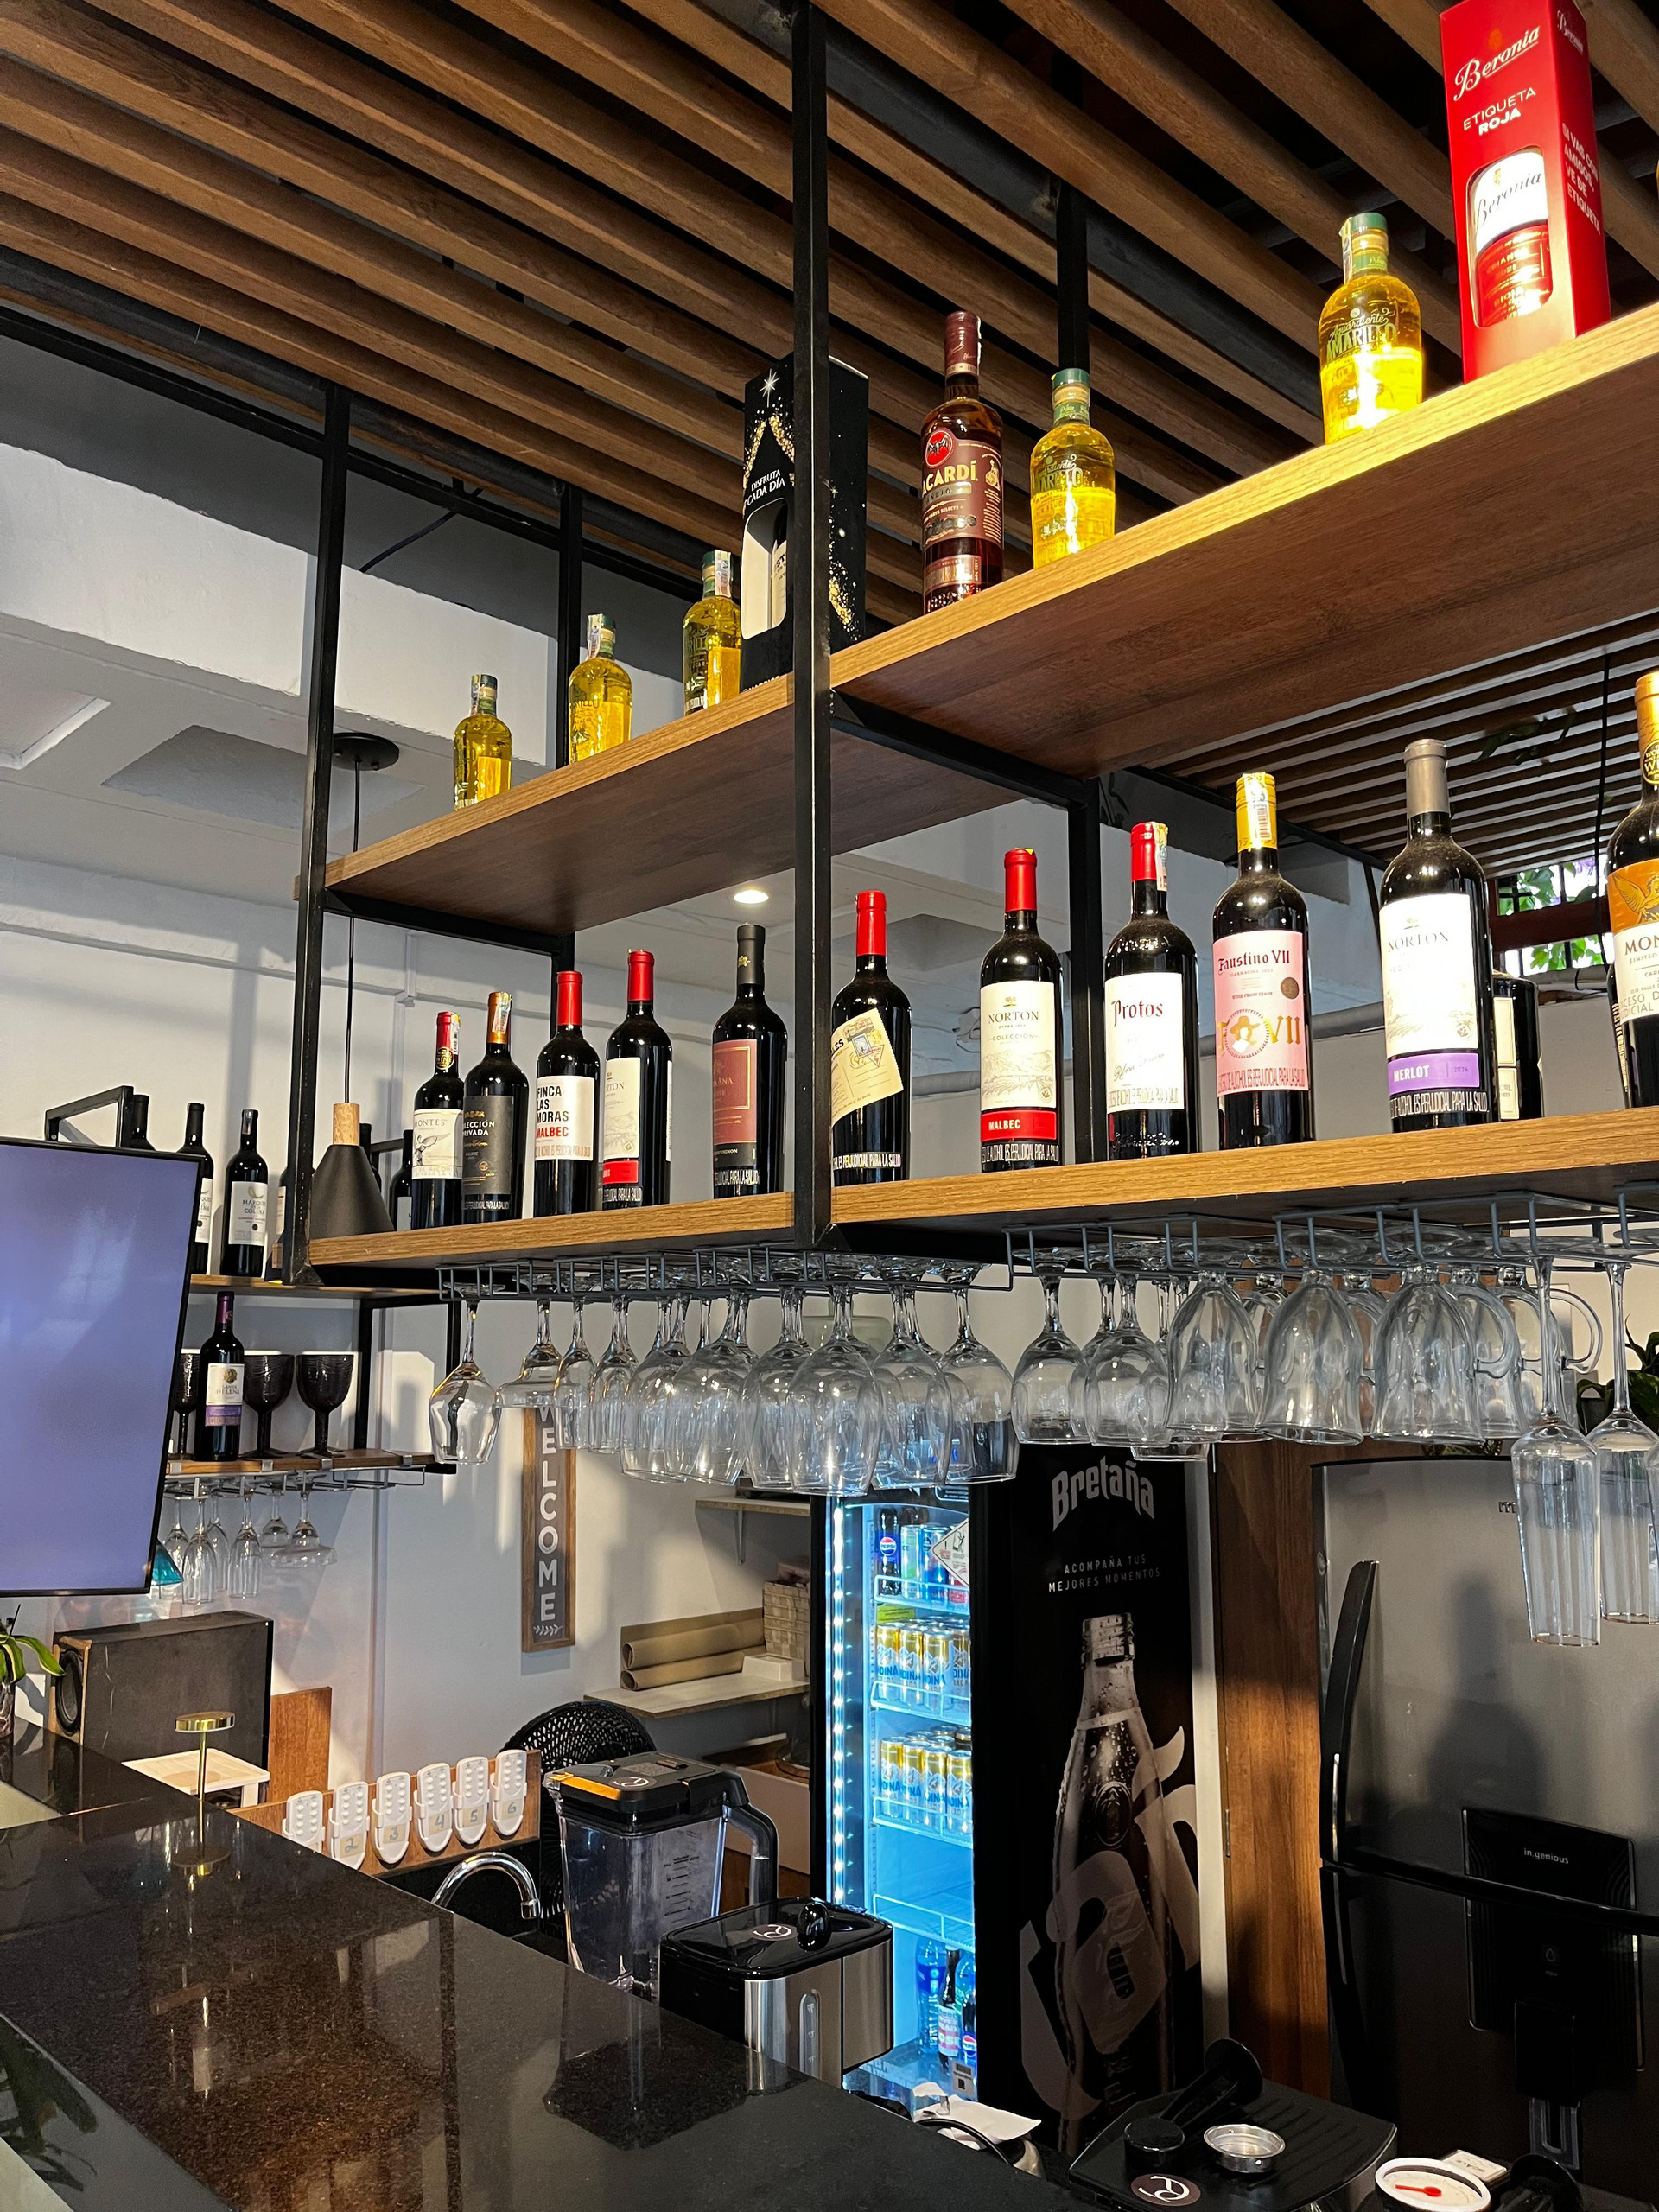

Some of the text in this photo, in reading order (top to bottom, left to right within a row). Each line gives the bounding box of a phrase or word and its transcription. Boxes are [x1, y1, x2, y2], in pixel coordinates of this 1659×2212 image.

[1453, 25, 1541, 102] Beronia
[1463, 86, 1536, 131] ETIQUETA
[1478, 107, 1522, 137] ROJA
[1570, 131, 1586, 160] VAS
[1565, 161, 1588, 199] VE DE
[1474, 172, 1541, 230] Beronia
[1567, 181, 1601, 236] ETIQUETA
[1325, 322, 1397, 365] AMARILLO
[751, 468, 781, 492] DISFRUTA
[922, 459, 978, 499] ACARDÍ
[747, 477, 786, 506] CADA DÍA
[1387, 931, 1449, 953] NORTON
[1217, 950, 1290, 976] Faustino VII
[988, 1010, 1039, 1025] NORTON
[1111, 1000, 1163, 1027] Protos
[1394, 1065, 1430, 1083] MERLOT
[537, 1085, 562, 1098] FINCA
[537, 1099, 550, 1110] LAS
[537, 1111, 569, 1122] MORAS
[988, 1118, 1021, 1131] MALBEC
[536, 1126, 569, 1139] MALBEC
[1051, 1455, 1155, 1533] Bretaña
[1064, 1554, 1147, 1574] ACOMPAÑA TUS
[1048, 1567, 1160, 1593] MEJORES MOMENTOS
[470, 1809, 479, 1822] 5
[506, 1801, 518, 1815] 6
[435, 1814, 446, 1828] 4
[389, 1827, 399, 1840] 3
[346, 1838, 359, 1853] 2
[1523, 1847, 1569, 1864] in.genious
